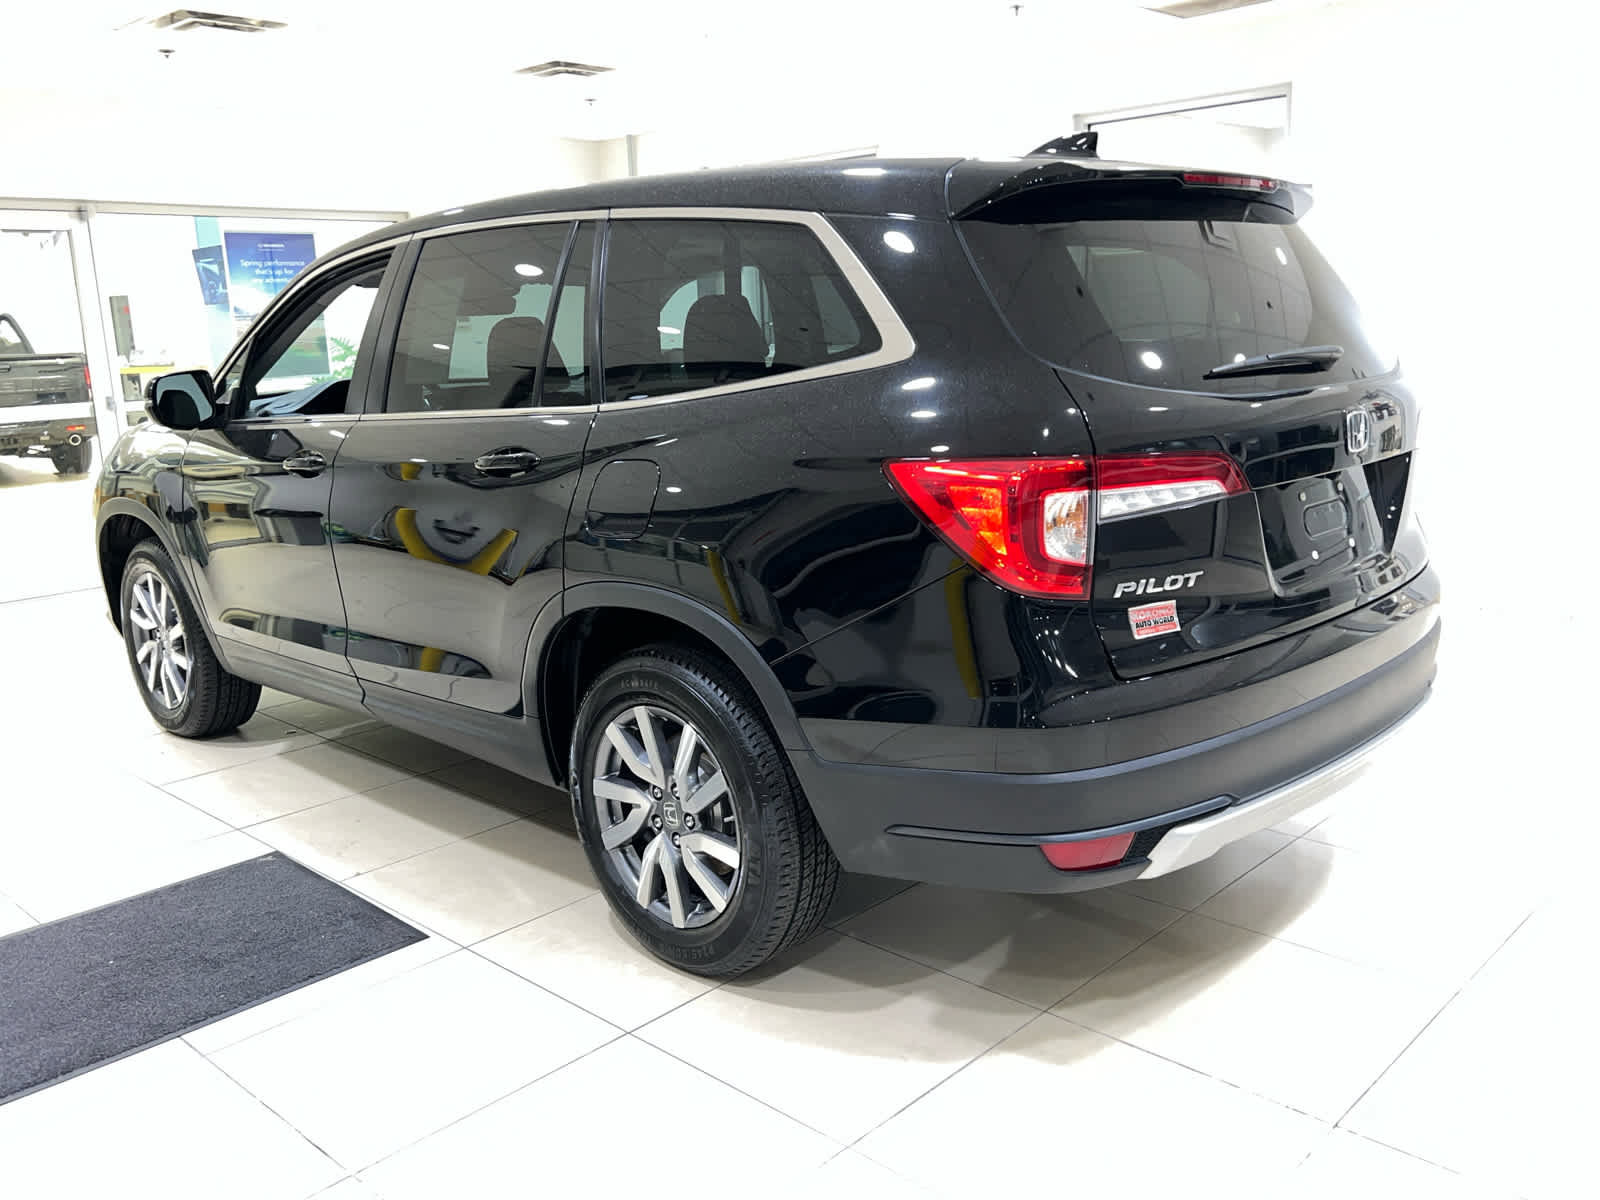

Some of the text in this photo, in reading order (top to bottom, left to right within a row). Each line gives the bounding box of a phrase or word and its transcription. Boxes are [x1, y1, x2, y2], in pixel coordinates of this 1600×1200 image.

[1113, 570, 1204, 599] PILOT
[1135, 615, 1175, 629] AUTO WORLD
